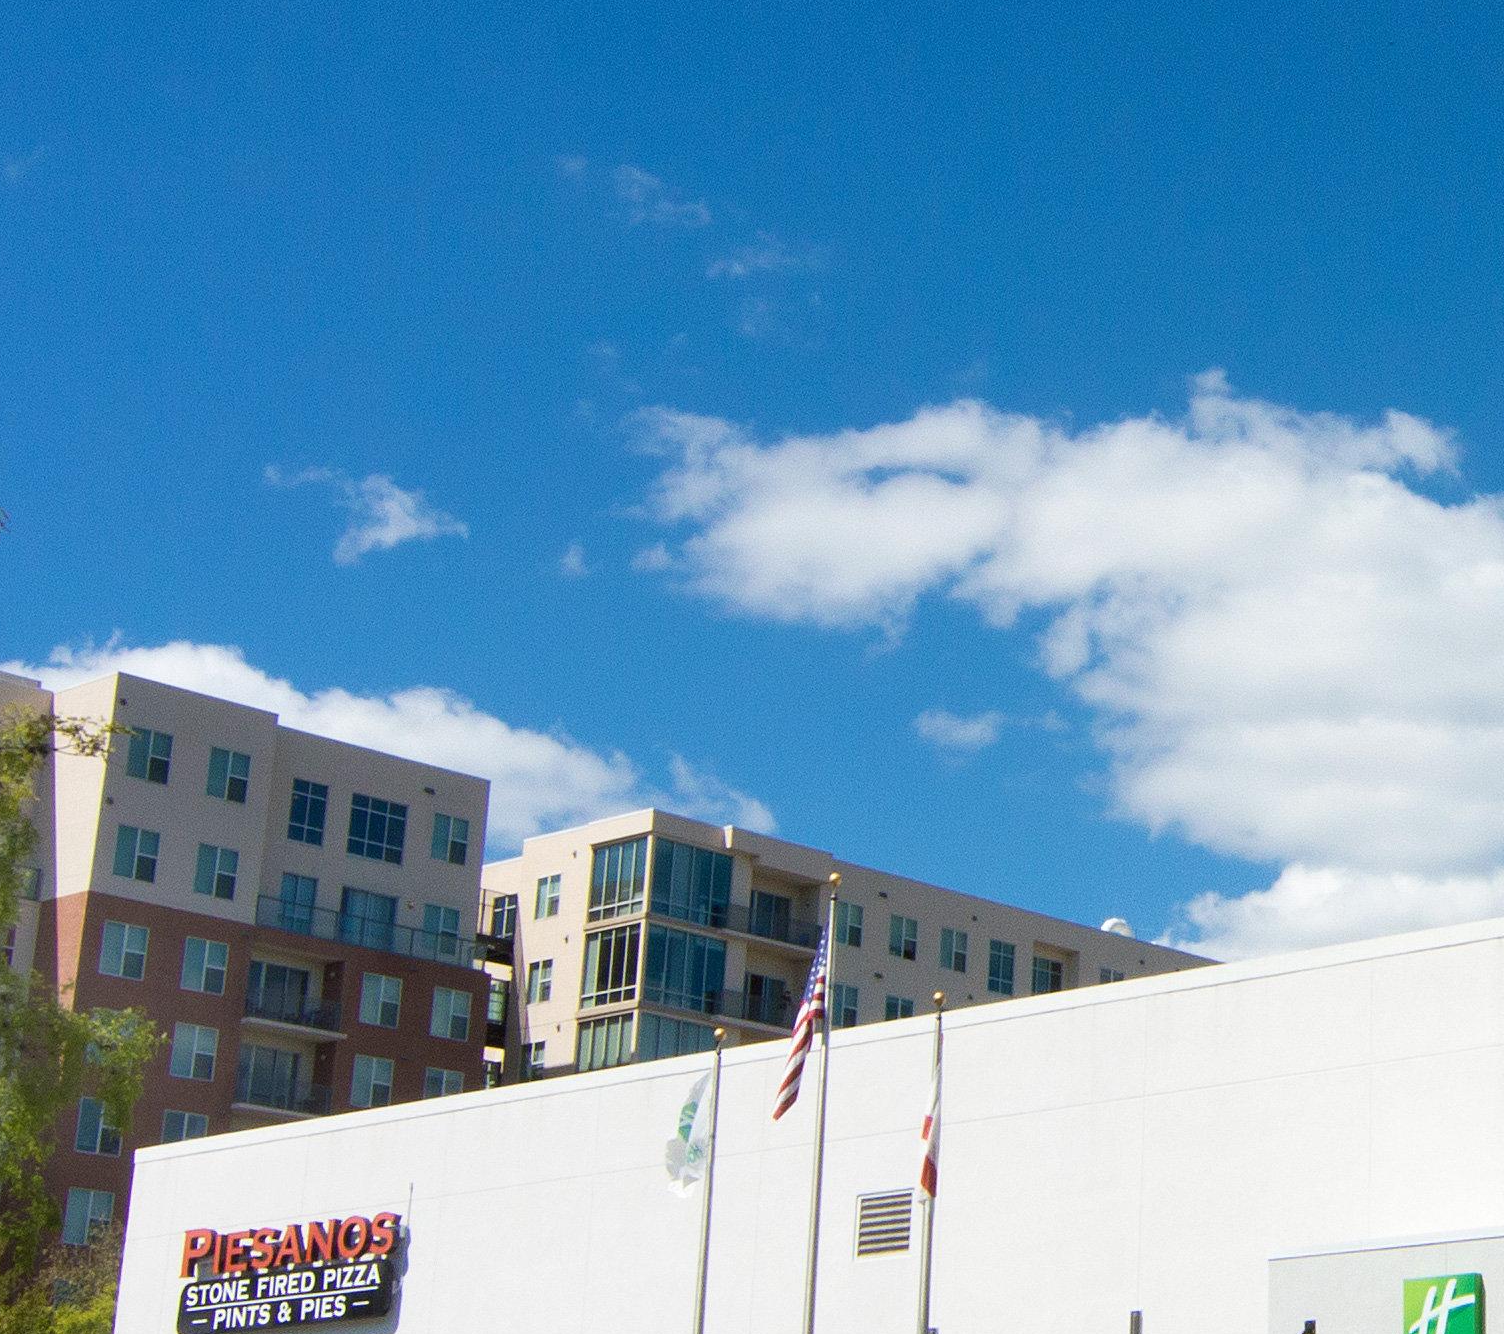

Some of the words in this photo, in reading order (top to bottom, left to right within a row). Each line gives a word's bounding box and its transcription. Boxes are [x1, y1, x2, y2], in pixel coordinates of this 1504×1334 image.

[179, 1212, 400, 1279] PIESANOS
[185, 1279, 250, 1308] STONE
[256, 1273, 316, 1299] FIRED
[323, 1264, 381, 1291] PIZZA
[213, 1304, 271, 1330] PINTS
[276, 1303, 291, 1323] &
[300, 1296, 347, 1319] PIES
